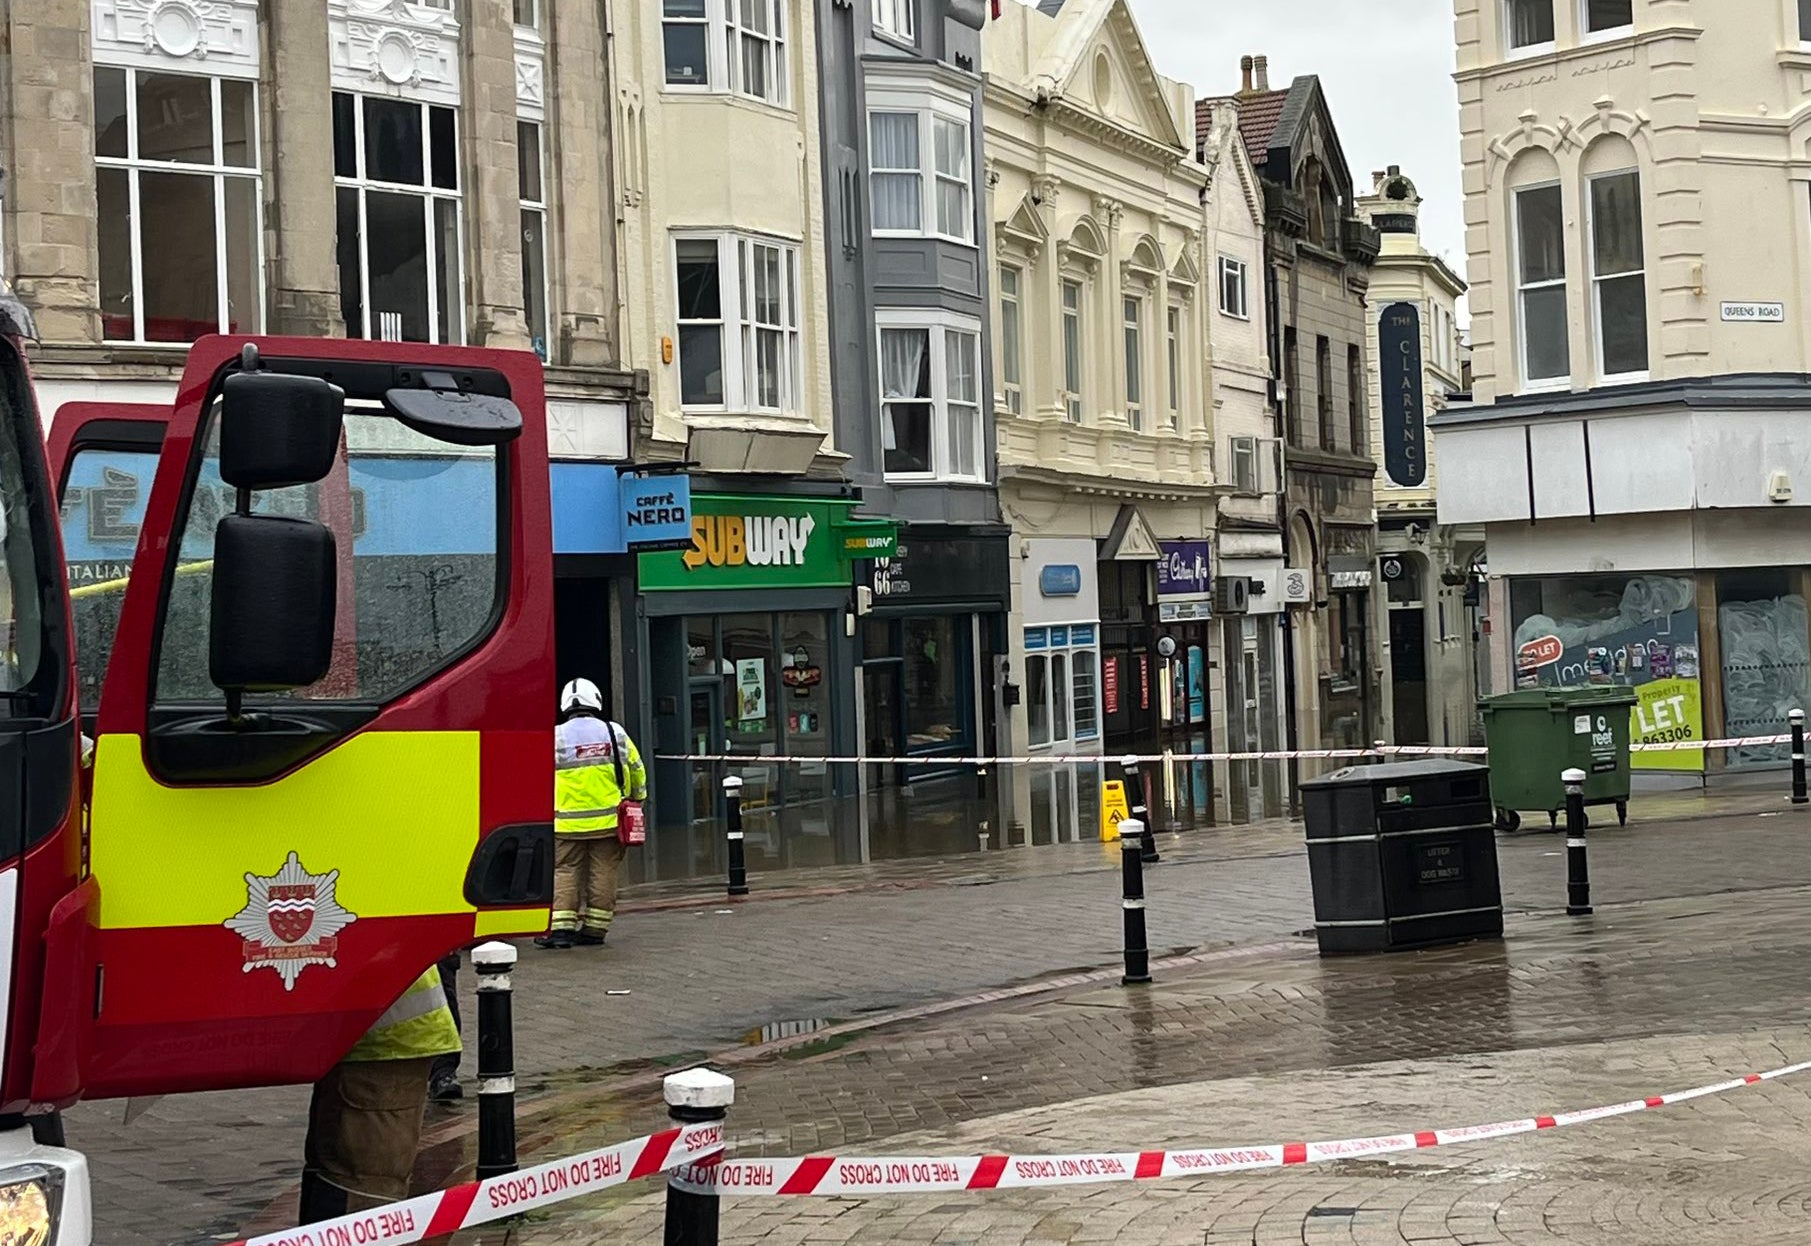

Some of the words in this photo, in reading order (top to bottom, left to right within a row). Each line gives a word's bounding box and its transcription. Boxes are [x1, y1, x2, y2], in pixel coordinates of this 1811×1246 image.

[1724, 306, 1755, 317] QUEENS
[1758, 306, 1780, 317] ROAD
[1399, 340, 1416, 478] CLARENCE
[636, 491, 675, 507] CAFFÈ
[627, 507, 686, 527] NERO
[682, 511, 816, 571] SUBWAY
[844, 536, 894, 549] SUBWAY
[873, 570, 891, 596] 66
[1539, 642, 1556, 657] LET
[1642, 685, 1681, 701] Property
[1636, 695, 1685, 734] LET
[1591, 727, 1613, 746] reef
[1642, 724, 1693, 745] 863306
[684, 1125, 722, 1152] ROSS
[571, 1160, 590, 1185] DO
[592, 1152, 622, 1180] FIRE
[686, 1164, 719, 1186] NOT
[721, 1165, 742, 1186] DO
[744, 1165, 773, 1186] FIRE
[840, 1164, 882, 1185] CROSS
[885, 1164, 910, 1184] NOT
[912, 1164, 931, 1183] DO
[932, 1163, 960, 1182] FIRE
[1015, 1160, 1056, 1179] CROSS
[1057, 1160, 1082, 1176] NOT
[1080, 1159, 1099, 1174] DO
[1097, 1158, 1126, 1174] FIRE
[541, 1167, 568, 1195] NOT
[488, 1176, 537, 1208] CROSS
[353, 1217, 378, 1244] DO
[379, 1208, 415, 1238] FIRE
